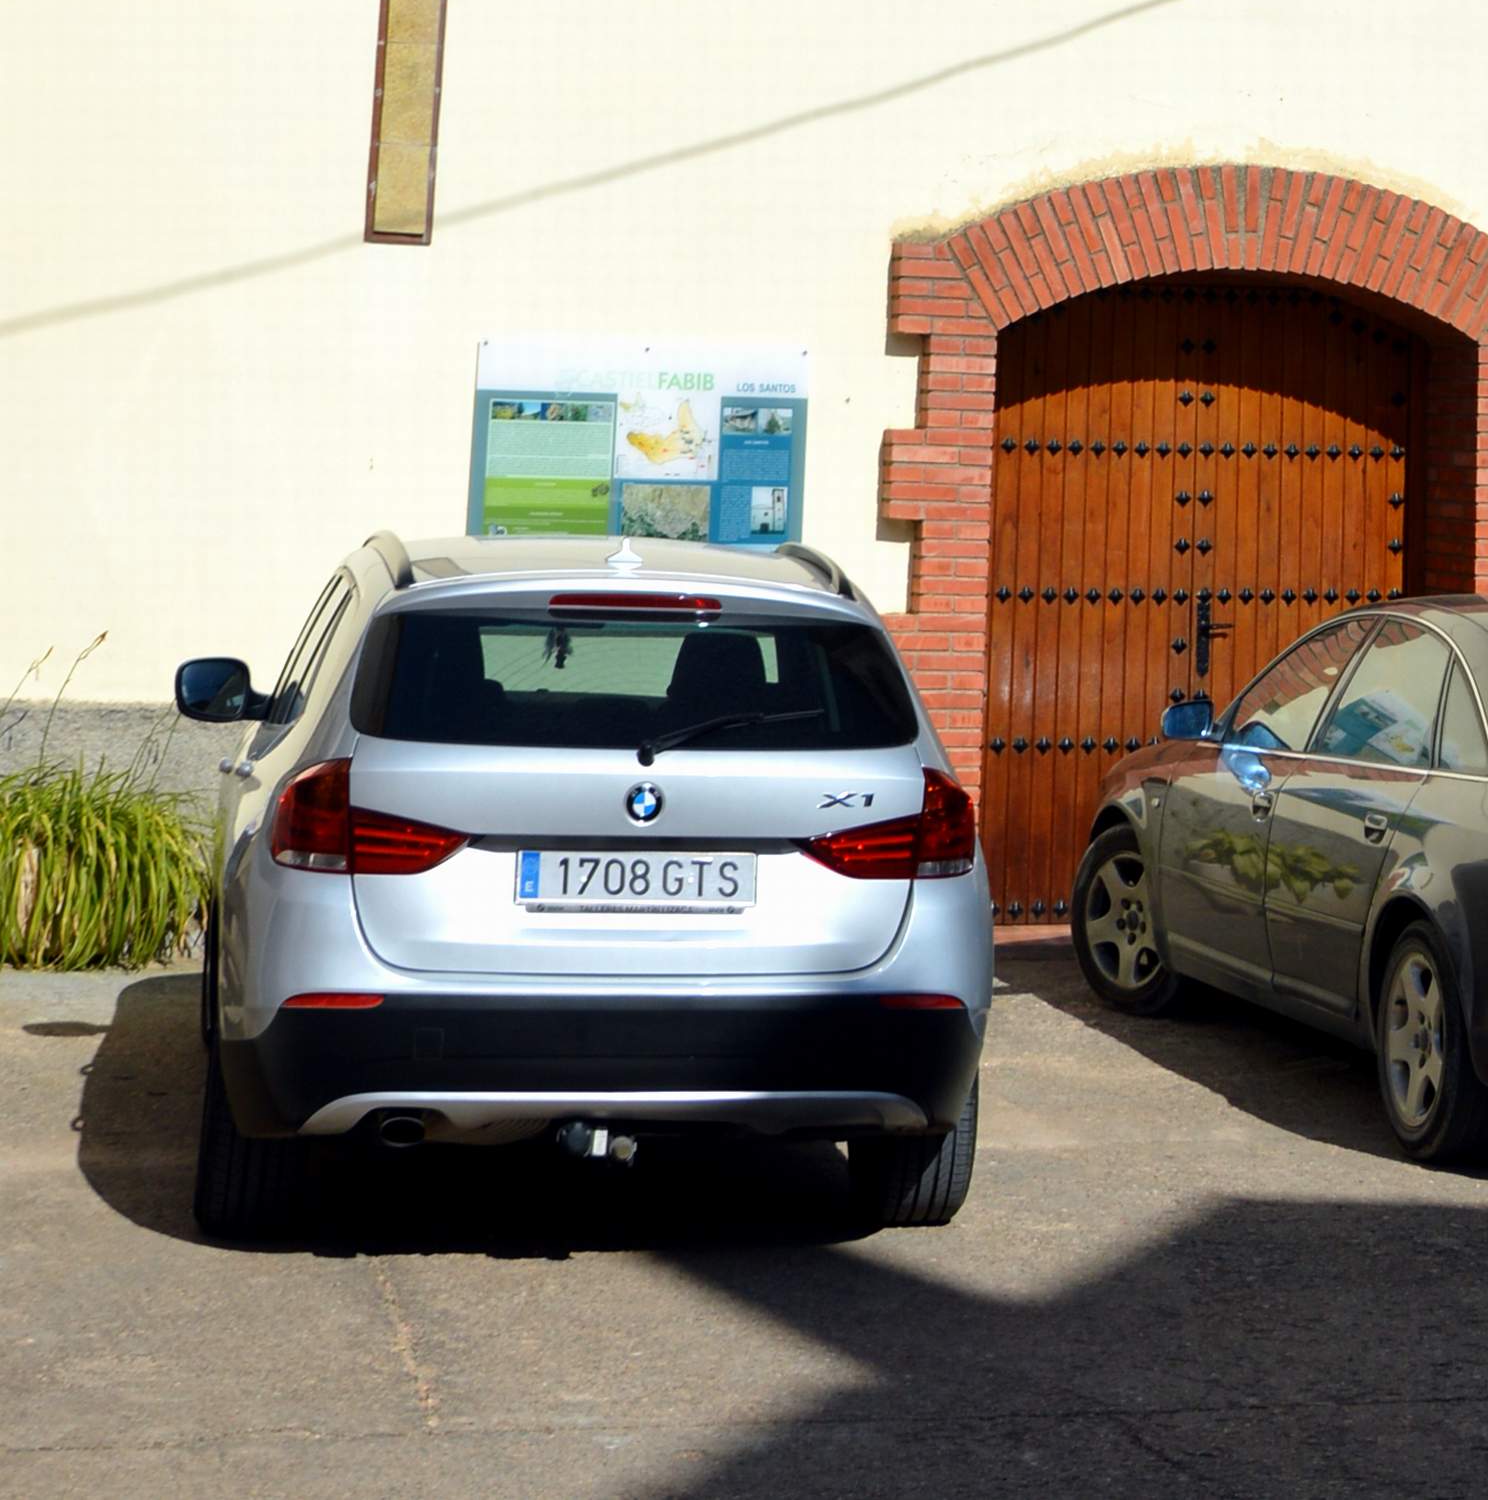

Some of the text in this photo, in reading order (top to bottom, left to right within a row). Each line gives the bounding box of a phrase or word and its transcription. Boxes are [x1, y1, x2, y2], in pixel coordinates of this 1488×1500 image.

[737, 383, 797, 393] LOS SANTOS
[816, 791, 875, 808] X1
[559, 857, 740, 897] 1708 GTS
[524, 881, 535, 892] E
